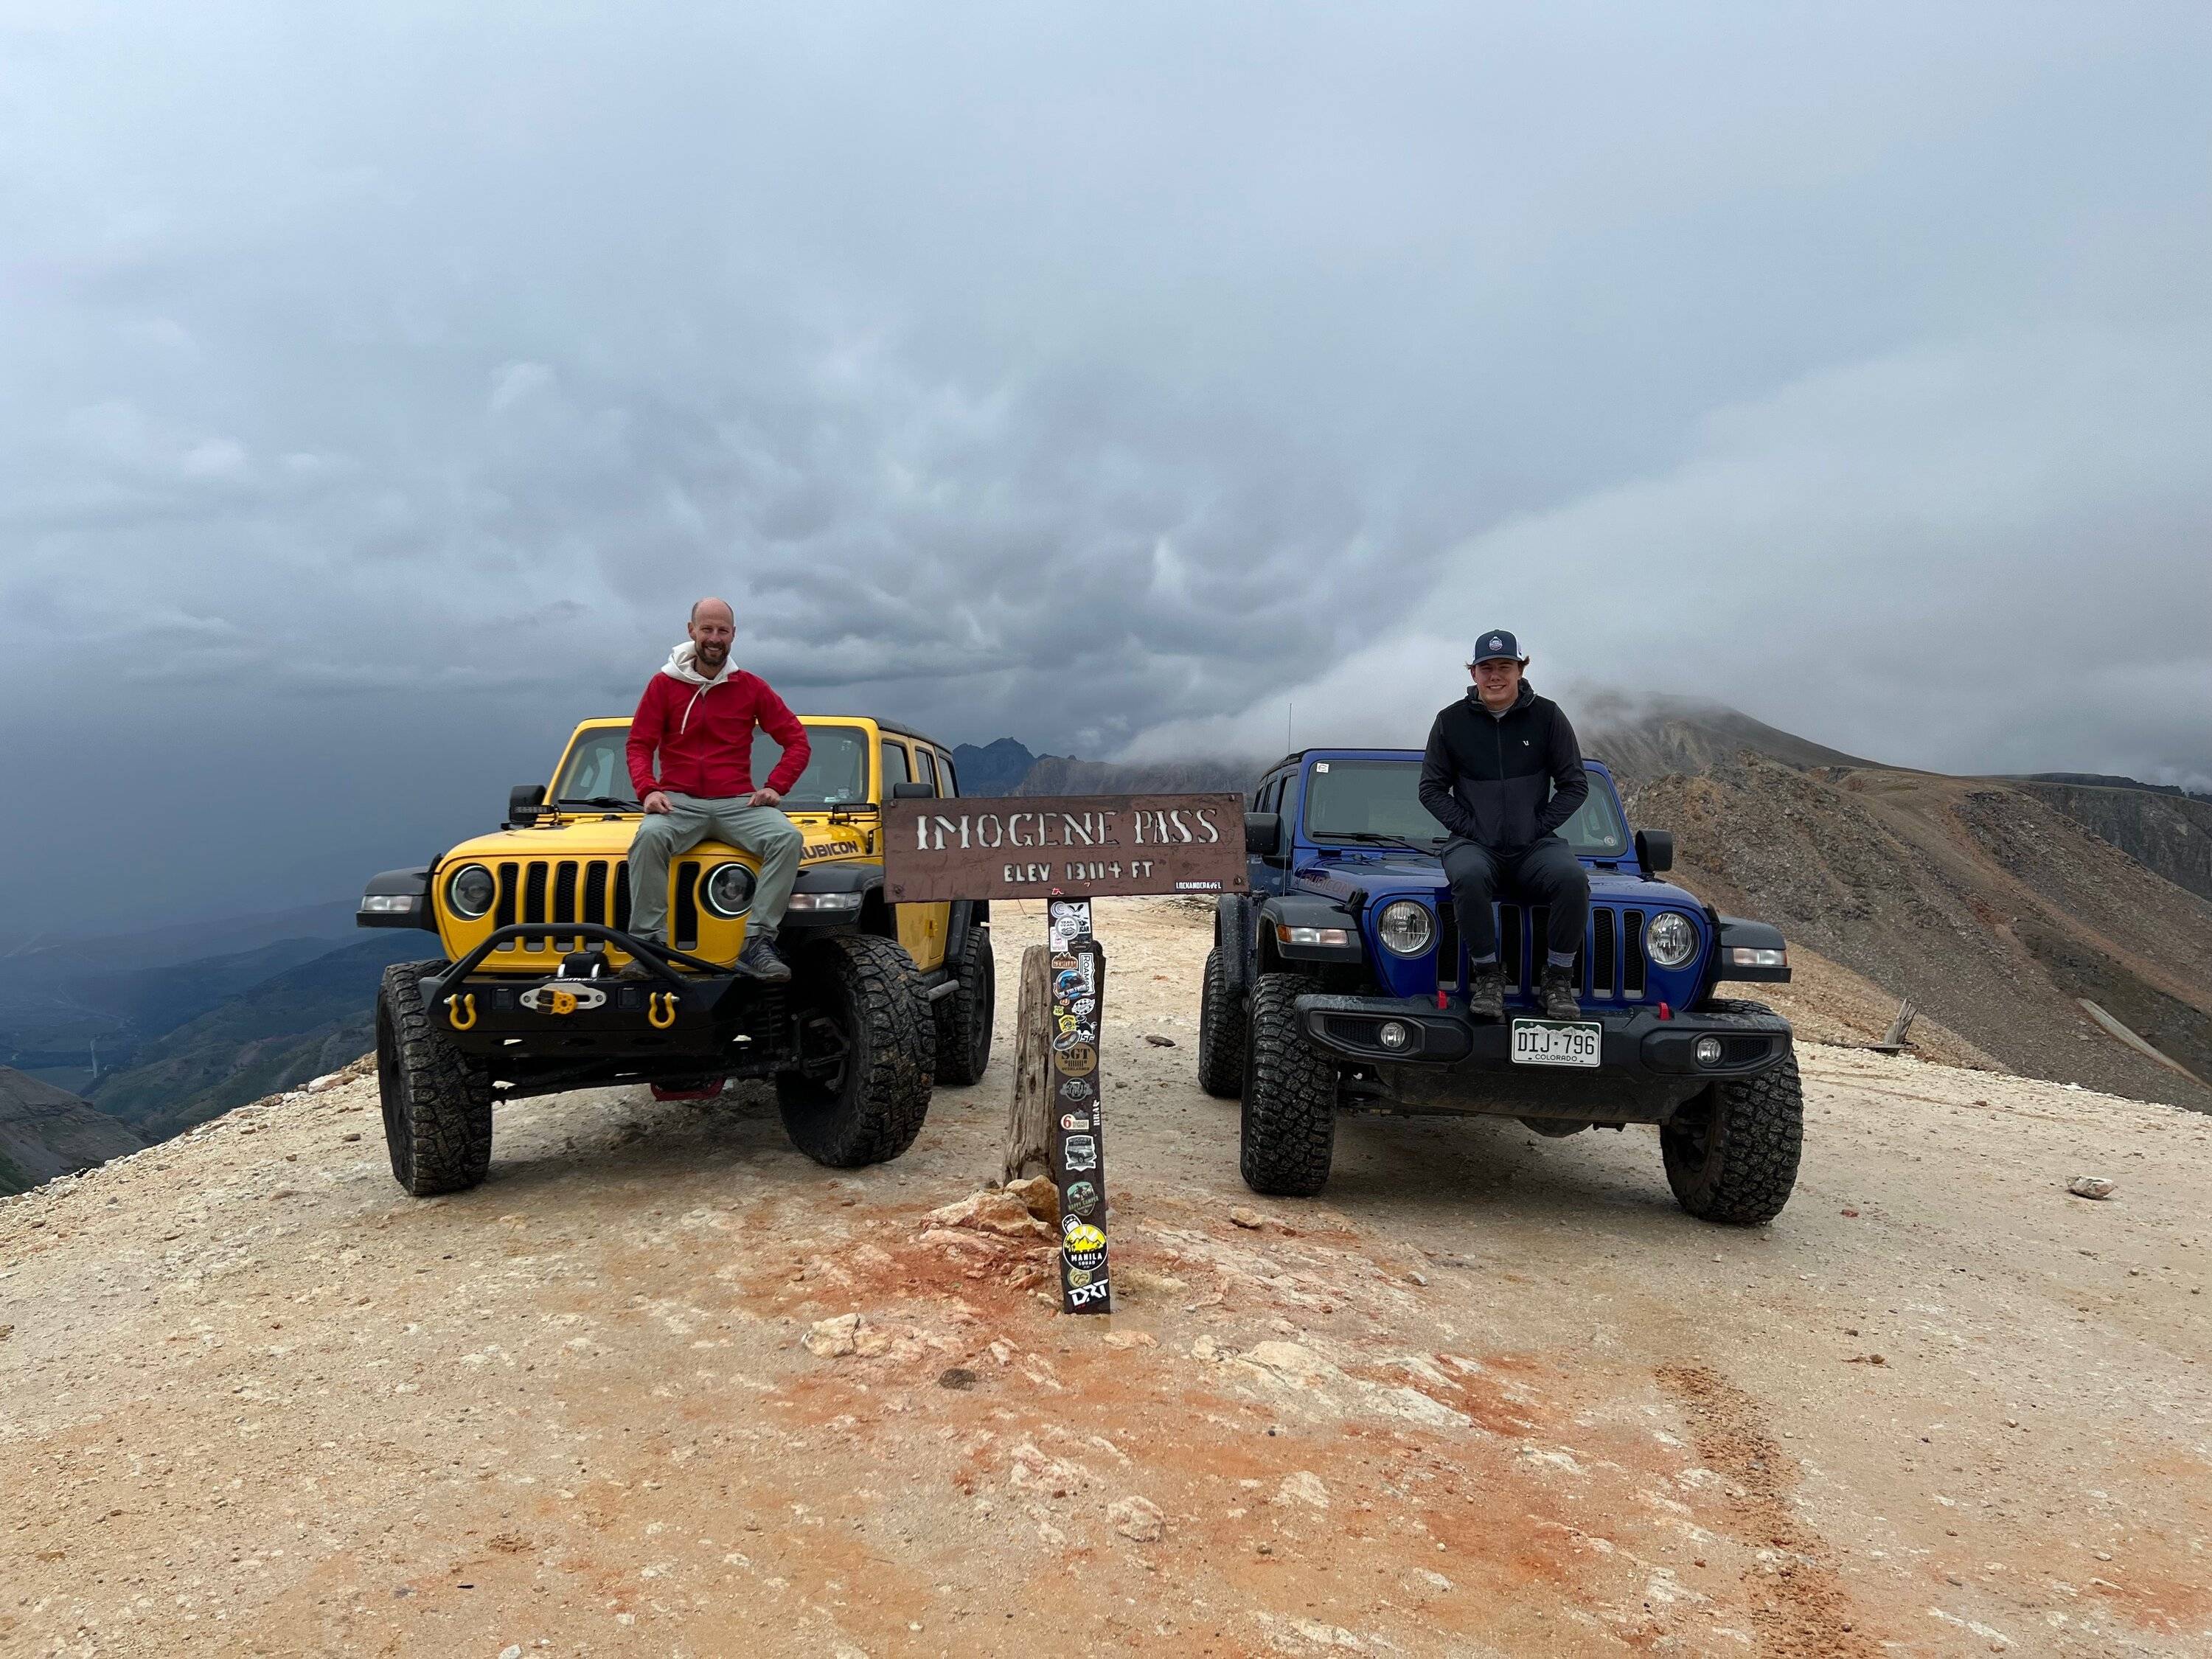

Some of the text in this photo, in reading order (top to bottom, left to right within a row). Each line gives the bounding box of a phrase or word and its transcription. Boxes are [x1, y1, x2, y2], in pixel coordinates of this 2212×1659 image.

[917, 809, 1219, 849] IMOGENE PASS
[1004, 860, 1155, 882] ELEV 13114 FT
[1062, 1048, 1090, 1059] SGT
[1534, 1054, 1577, 1062] COLORADO
[1063, 1116, 1072, 1128] 6
[1071, 1253, 1102, 1262] MANILA
